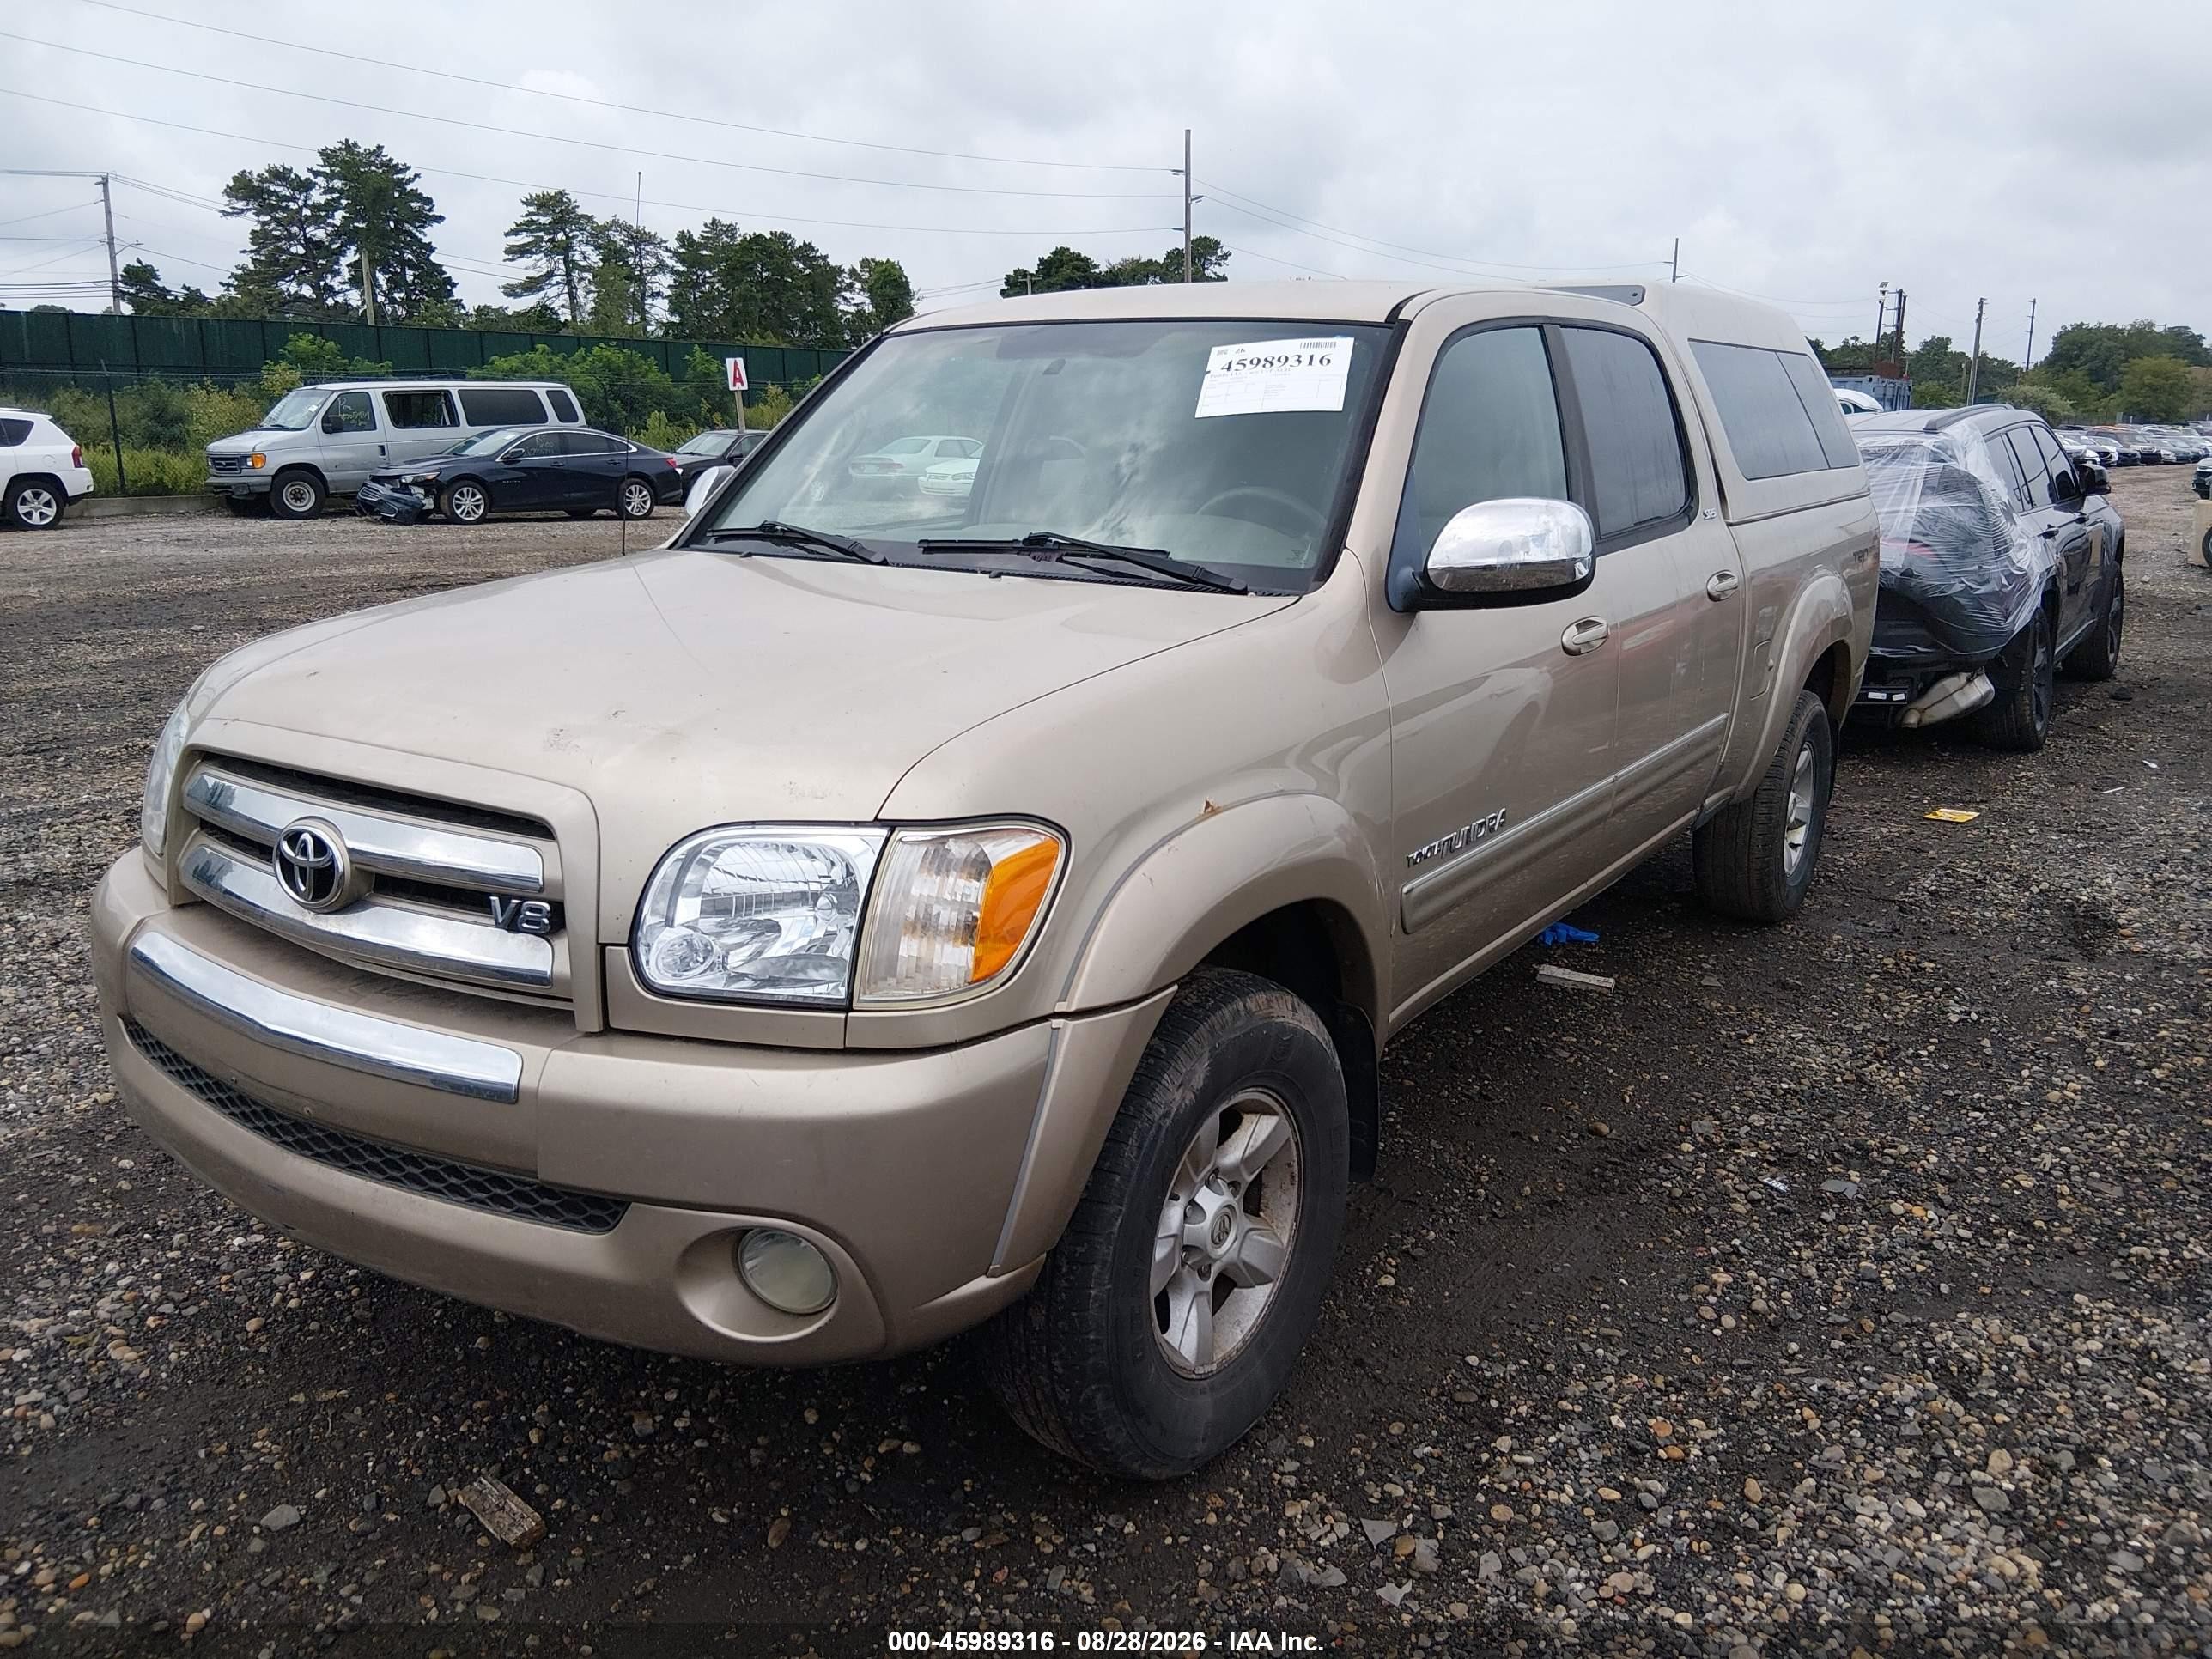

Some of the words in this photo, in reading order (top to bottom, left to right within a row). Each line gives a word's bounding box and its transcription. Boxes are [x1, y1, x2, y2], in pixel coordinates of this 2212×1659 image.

[732, 359, 744, 387] A
[1220, 353, 1334, 373] 45989316
[1440, 807, 1506, 860] TUNDRA
[489, 896, 551, 934] V8
